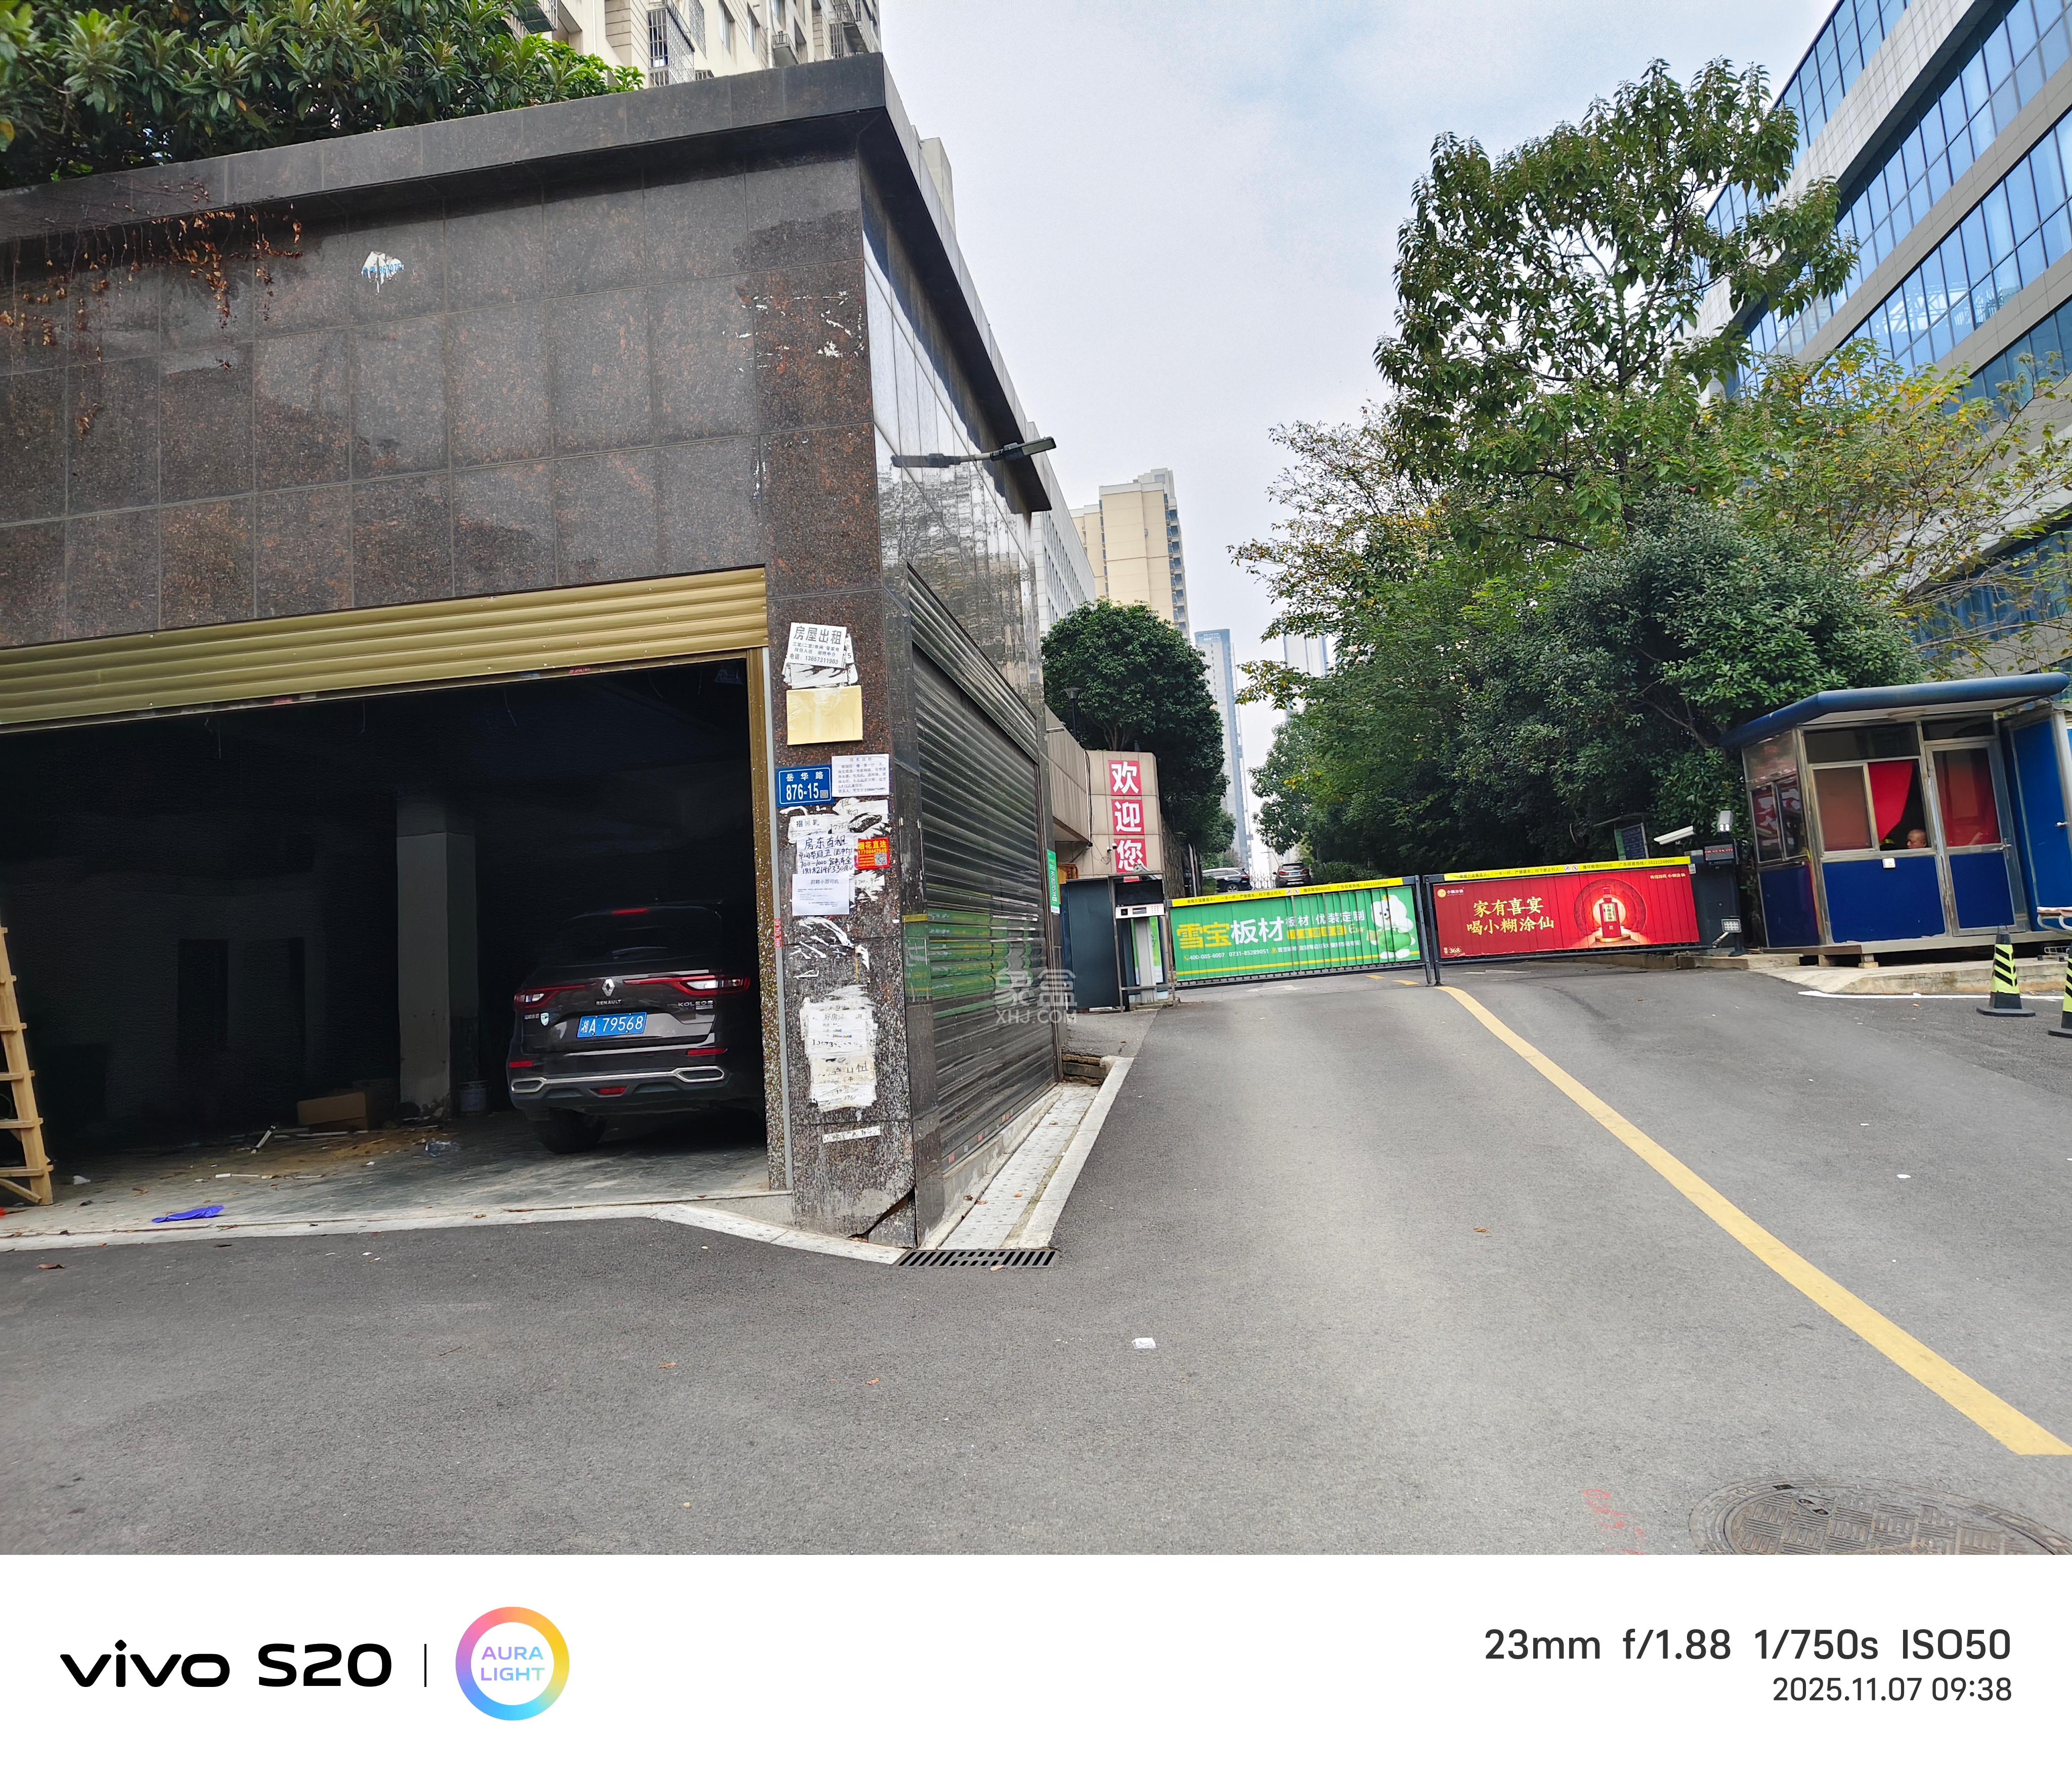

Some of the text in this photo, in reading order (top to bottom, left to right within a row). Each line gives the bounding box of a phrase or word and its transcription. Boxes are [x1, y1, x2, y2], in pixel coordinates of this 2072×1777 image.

[793, 625, 842, 645] 房屋出租
[786, 772, 824, 782] 岳华路
[786, 783, 819, 801] 876-15
[1110, 760, 1145, 872] 欢迎您
[804, 835, 848, 850] 房东直租
[1473, 896, 1544, 918] 家有喜宴
[1176, 916, 1285, 949] 雪宝板材
[1466, 915, 1555, 937] 喝小糊涂仙
[1229, 948, 1269, 957] 0731-85289051
